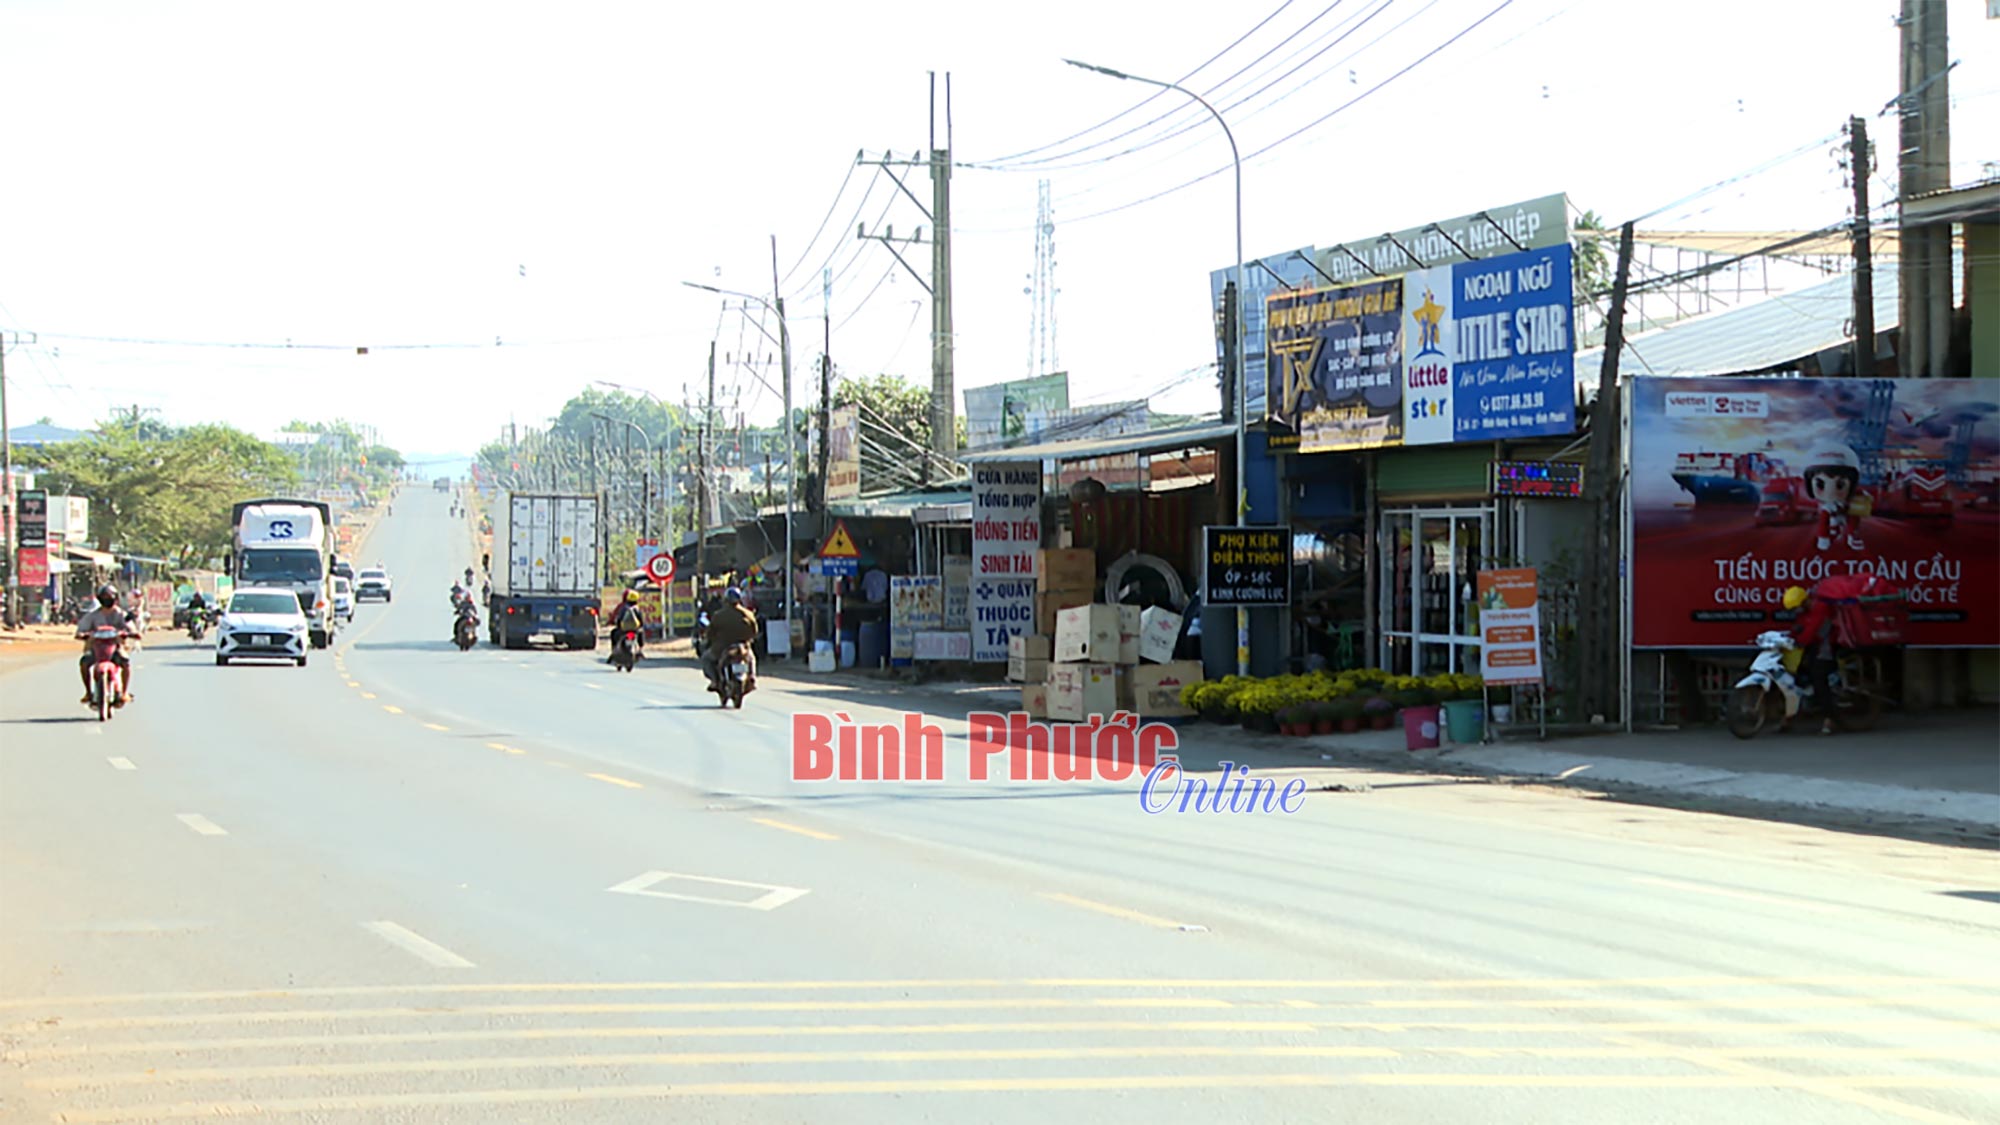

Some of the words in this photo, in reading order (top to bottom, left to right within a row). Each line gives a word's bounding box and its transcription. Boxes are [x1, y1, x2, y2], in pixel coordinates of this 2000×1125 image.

[1469, 208, 1541, 252] NGHIỆP
[1464, 269, 1511, 303] NGOẠI
[1518, 256, 1553, 294] NGỮ
[1453, 312, 1512, 366] LITTLE
[1515, 304, 1568, 356] STAR
[1408, 363, 1449, 389] little
[1005, 467, 1037, 486] HÀNG
[1012, 515, 1038, 541] TIẾN
[655, 559, 670, 573] 60
[981, 554, 1011, 574] SINH
[1714, 551, 1768, 581] TIẾN
[1773, 555, 1839, 581] BƯỚC
[1843, 555, 1908, 581] TOÀN
[1913, 551, 1962, 581] CẦU
[1714, 583, 1762, 605] CÙNG
[1938, 582, 1960, 604] TẾ
[976, 600, 1031, 621] THUỐC
